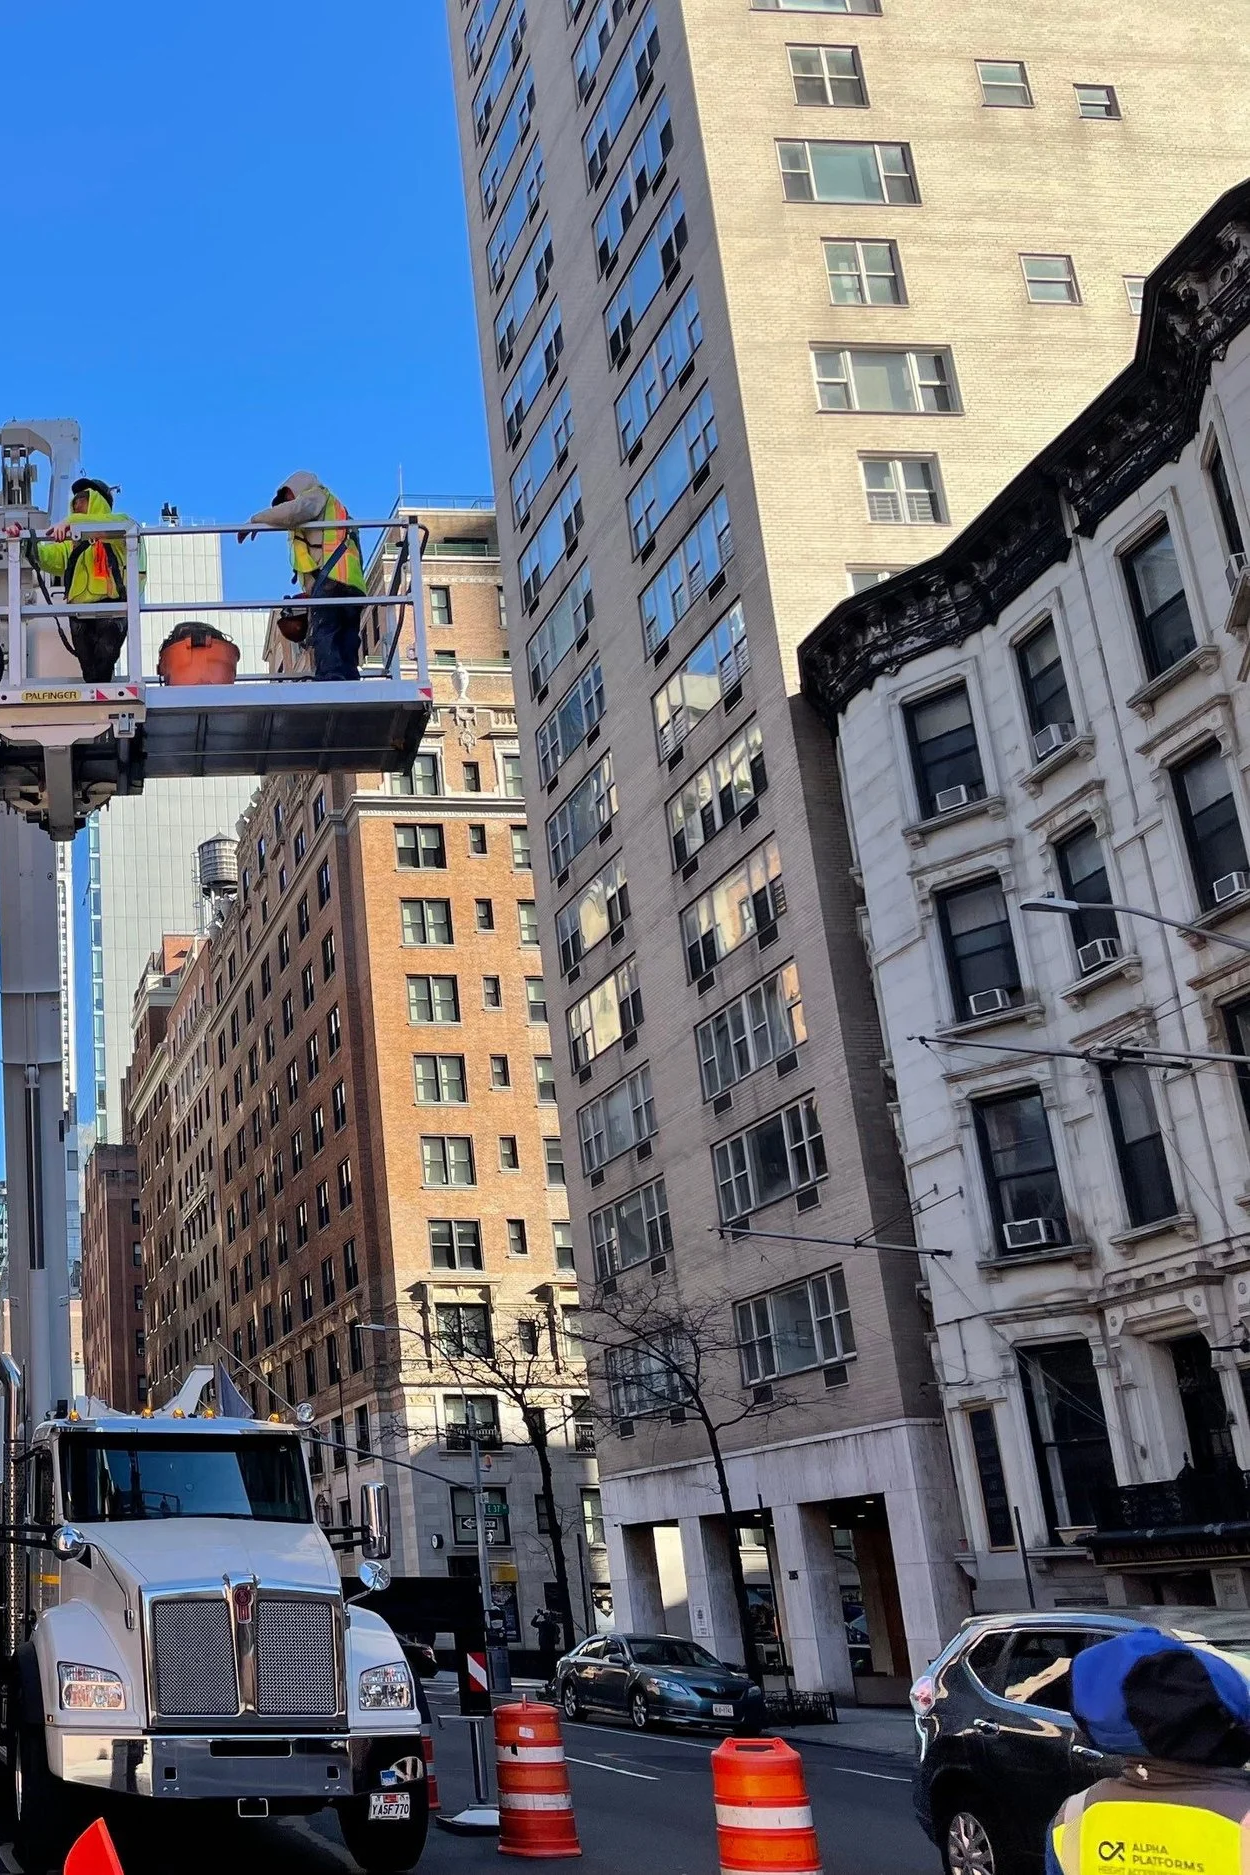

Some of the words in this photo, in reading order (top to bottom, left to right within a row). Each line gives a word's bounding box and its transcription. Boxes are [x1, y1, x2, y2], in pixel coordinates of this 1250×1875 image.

[25, 691, 77, 701] PALFINGER
[1132, 1843, 1168, 1855] ALPHA
[1132, 1854, 1205, 1873] PLATFORMS
